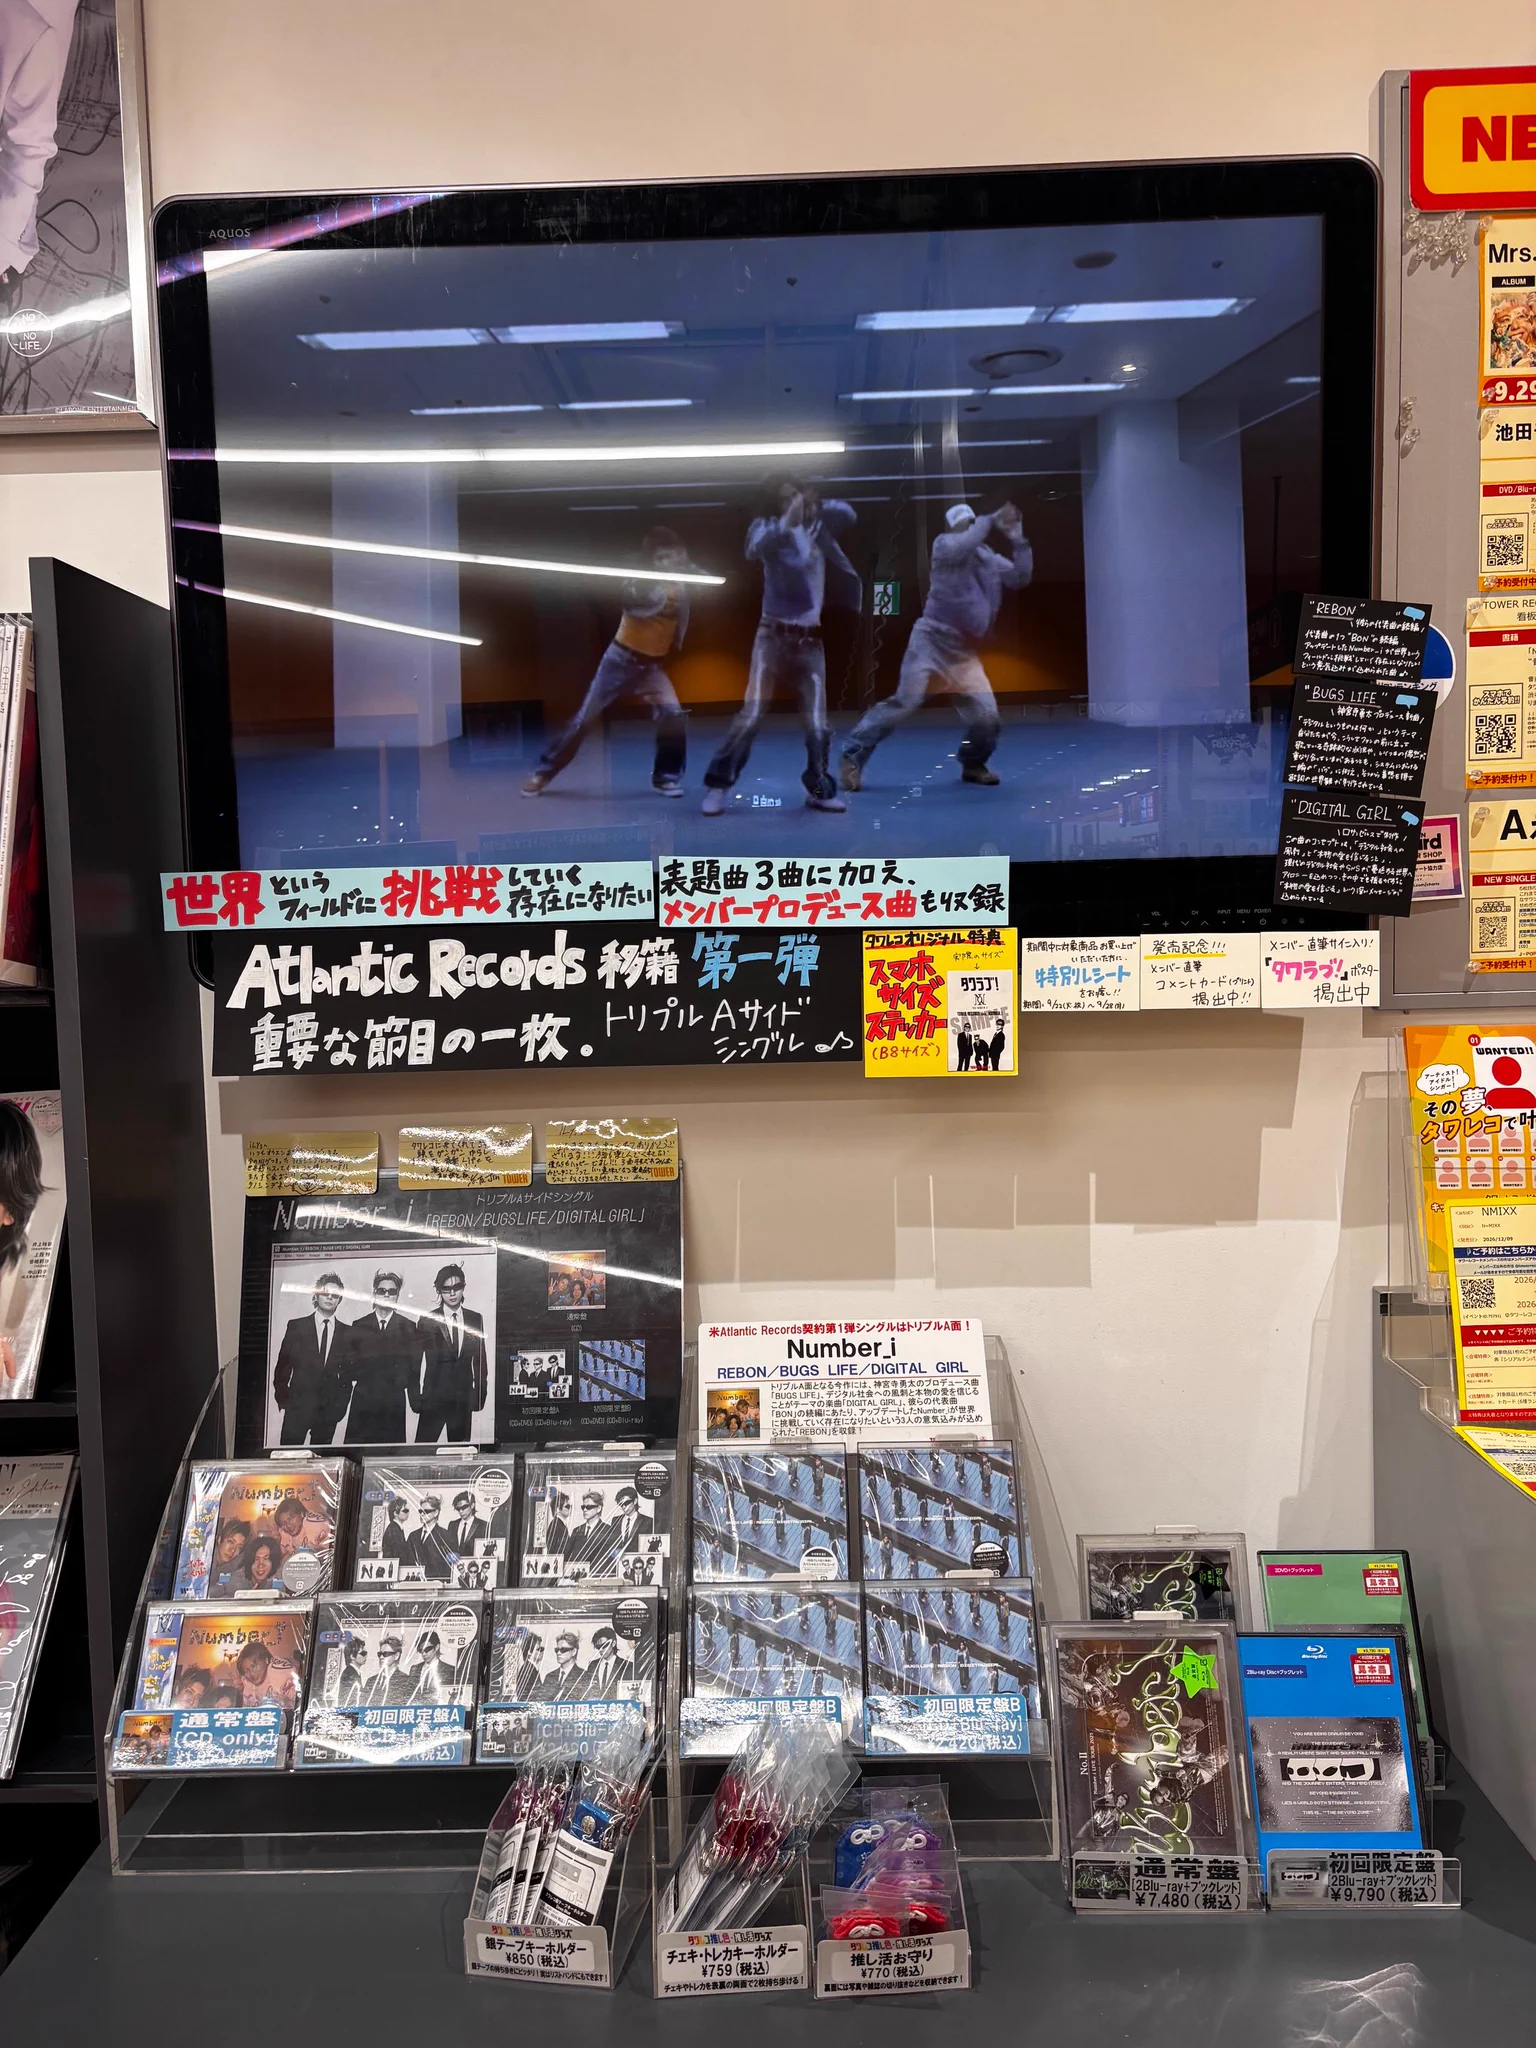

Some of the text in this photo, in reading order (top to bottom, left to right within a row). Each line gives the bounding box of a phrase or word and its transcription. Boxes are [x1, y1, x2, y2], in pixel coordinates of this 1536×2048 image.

[1462, 114, 1536, 163] NE
[209, 228, 251, 239] AQUOS
[1501, 278, 1527, 286] ALBUM
[24, 332, 37, 341] NO
[1496, 423, 1536, 442] 池田
[1483, 599, 1536, 610] TOWER RE
[269, 871, 330, 895] という
[508, 864, 582, 887] していく
[1484, 875, 1535, 884] NEW SINGLE
[166, 871, 266, 927] 世界
[380, 865, 504, 919] 挑戦
[507, 880, 653, 919] 存在になりたい
[278, 889, 377, 921] フィールドに
[225, 929, 821, 1010] Atlantic Records 移籍 第一弾
[869, 950, 937, 986] スマホ
[1035, 964, 1131, 989] 特別レシート
[877, 970, 947, 1010] サイズ
[1313, 983, 1371, 1005] 掲出中
[865, 1009, 948, 1042] ステッカー
[949, 1006, 1011, 1035] SAMPLE
[249, 1011, 594, 1072] 重要な節目の一枚。
[714, 1032, 805, 1064] シングル
[1475, 1047, 1534, 1055] WANTED!!
[503, 1173, 528, 1184] TOWER
[650, 1167, 675, 1177] TOWER
[1481, 1206, 1518, 1217] NMIXX
[709, 1326, 759, 1337] 米Atlantic
[787, 1337, 897, 1360] Number_i
[936, 1361, 969, 1374] GIRL
[1357, 1665, 1388, 1675] 見本品
[364, 1707, 460, 1725] 初回限定盤A
[923, 1698, 1020, 1713] 初回限定盤B
[180, 1710, 277, 1728] 通常盤
[1134, 1856, 1240, 1880] 通常盤
[1329, 1852, 1436, 1874] 初回限定盤
[485, 1936, 587, 1954] 銀テープキーホルダー
[850, 1948, 934, 1967] 推し活お守り
